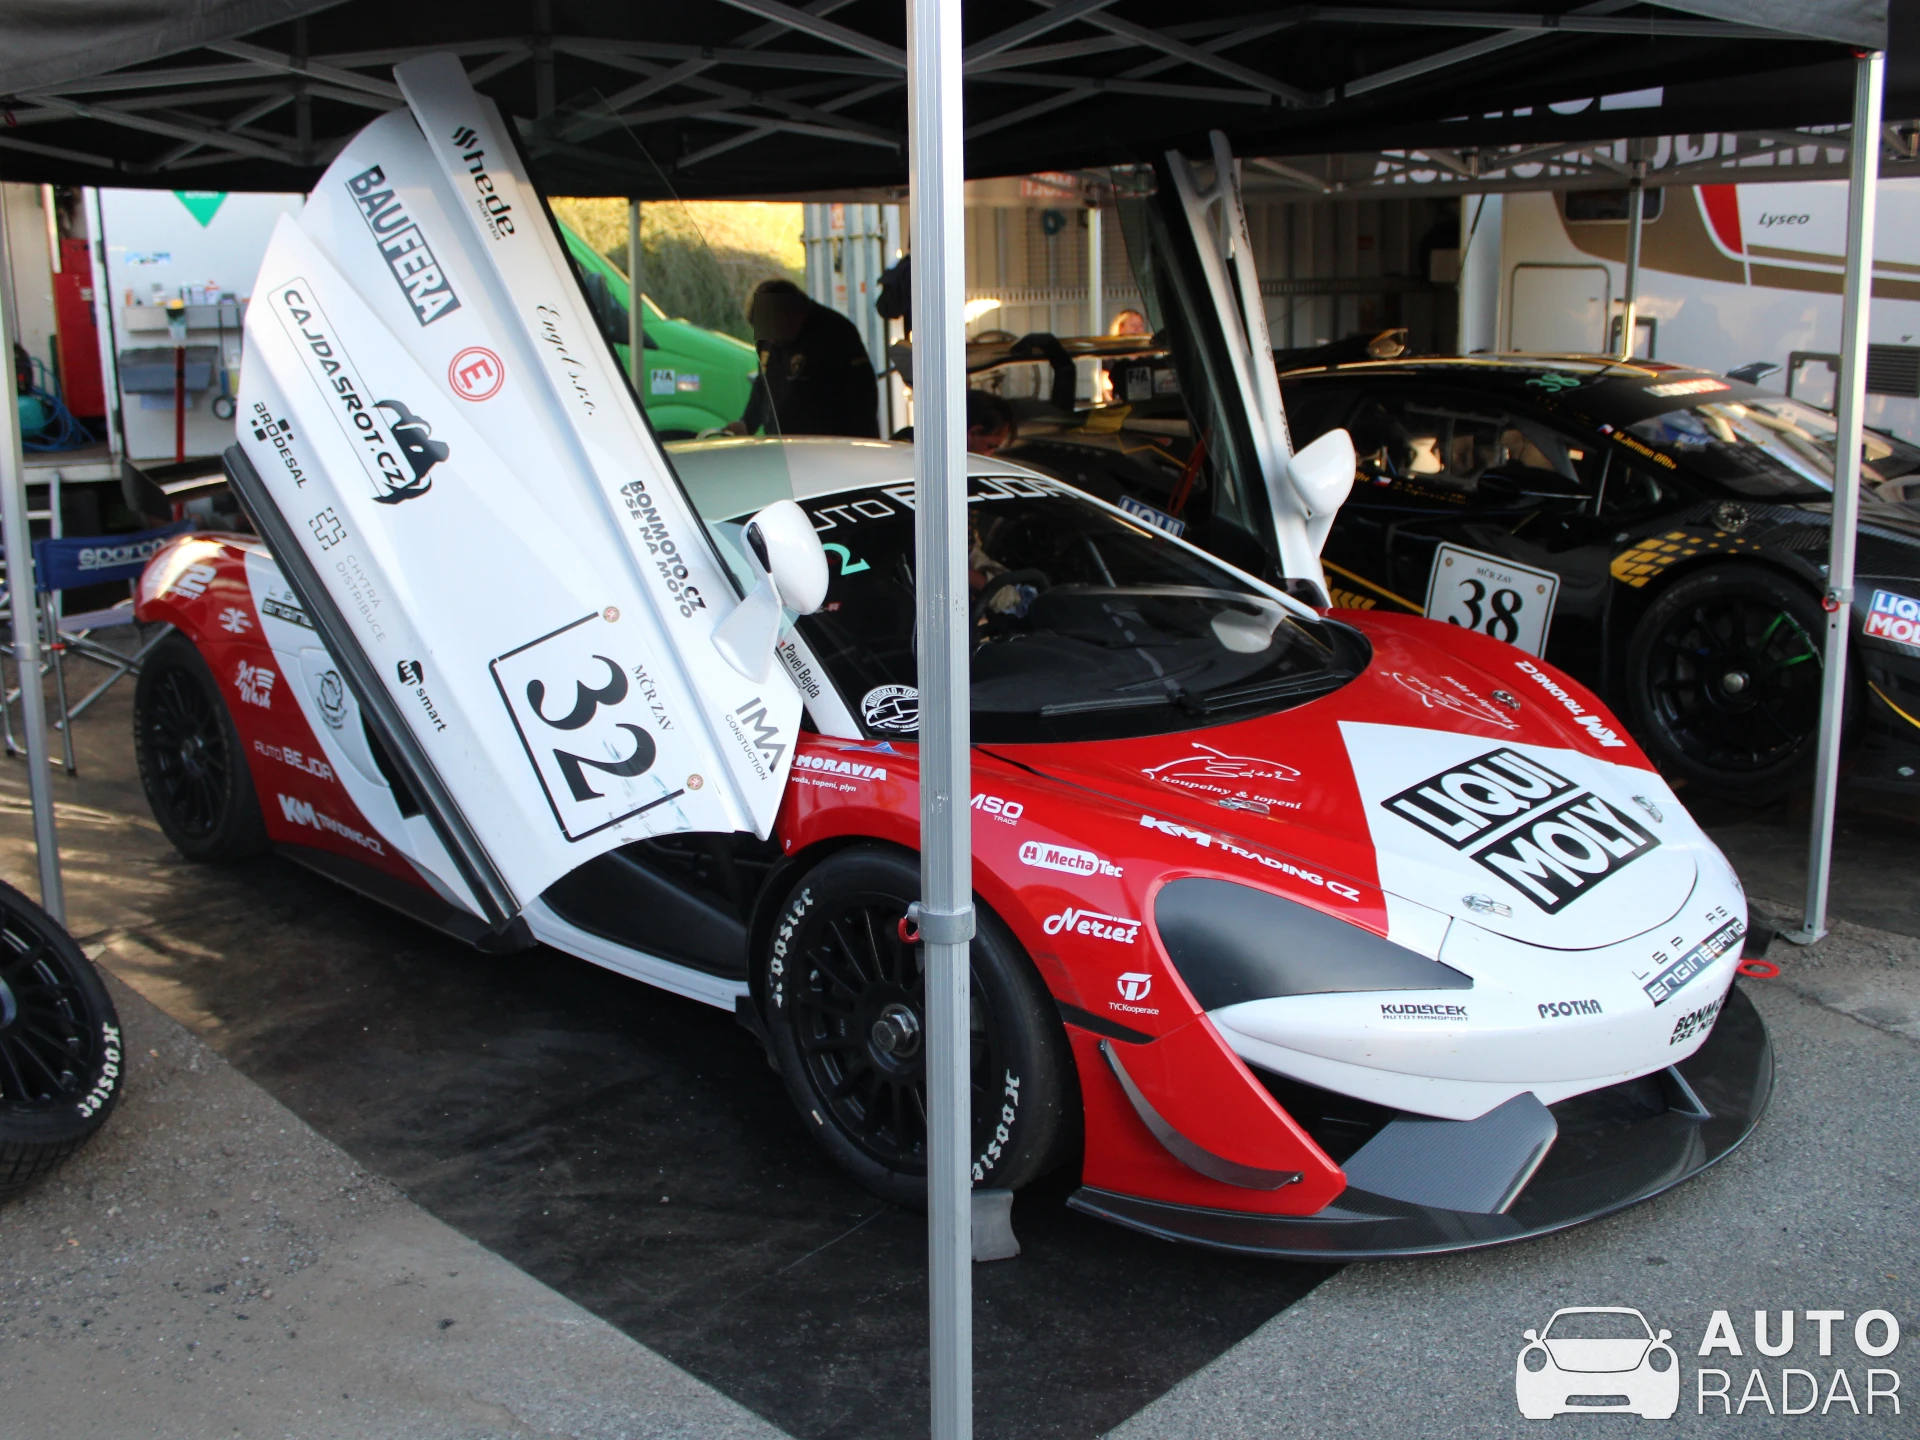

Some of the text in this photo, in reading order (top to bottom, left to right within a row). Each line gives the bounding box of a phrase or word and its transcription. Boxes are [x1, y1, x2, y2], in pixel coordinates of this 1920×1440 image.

[463, 150, 515, 238] hede
[1758, 212, 1811, 229] Lyseo
[347, 163, 457, 326] BAUFERA
[283, 289, 407, 485] CAJDASROT.CZ
[459, 358, 494, 400] E
[568, 370, 596, 416] s.r.o.
[253, 401, 307, 488] BRODESAL
[628, 480, 707, 612] BONMOTO.CZ
[813, 499, 895, 532] UTO
[336, 562, 386, 643] DISTRIBUCE
[346, 555, 382, 609] CHYTRÁ
[639, 526, 660, 555] NA
[656, 561, 692, 618] MOTO
[1448, 578, 1523, 645] 38
[1874, 593, 1920, 622] LIQ
[631, 664, 675, 732] MČR ZAV
[784, 643, 820, 700] Pavel Bejda
[1531, 673, 1586, 716] TRADING
[416, 687, 447, 732] smart
[526, 654, 657, 803] 32
[735, 696, 787, 774] IMA
[1573, 714, 1627, 748] KM
[282, 746, 334, 783] BEJDA
[725, 714, 767, 781] CONSTUCTION
[796, 755, 887, 781] MORAVIA
[277, 793, 322, 831] KM
[791, 775, 857, 792] voda, topení, plyn
[1160, 776, 1303, 811] koupelny & topení
[1392, 751, 1569, 843] LIQUI
[993, 815, 1018, 827] TRADE
[1484, 796, 1648, 906] MOLY
[1139, 814, 1361, 903] KM TRADING CZ
[1647, 920, 1747, 1001] ENGINEERING
[1537, 999, 1604, 1019] PSOTKA
[77, 1021, 121, 1118] Hoosier
[971, 1068, 1020, 1188] Hoosie
